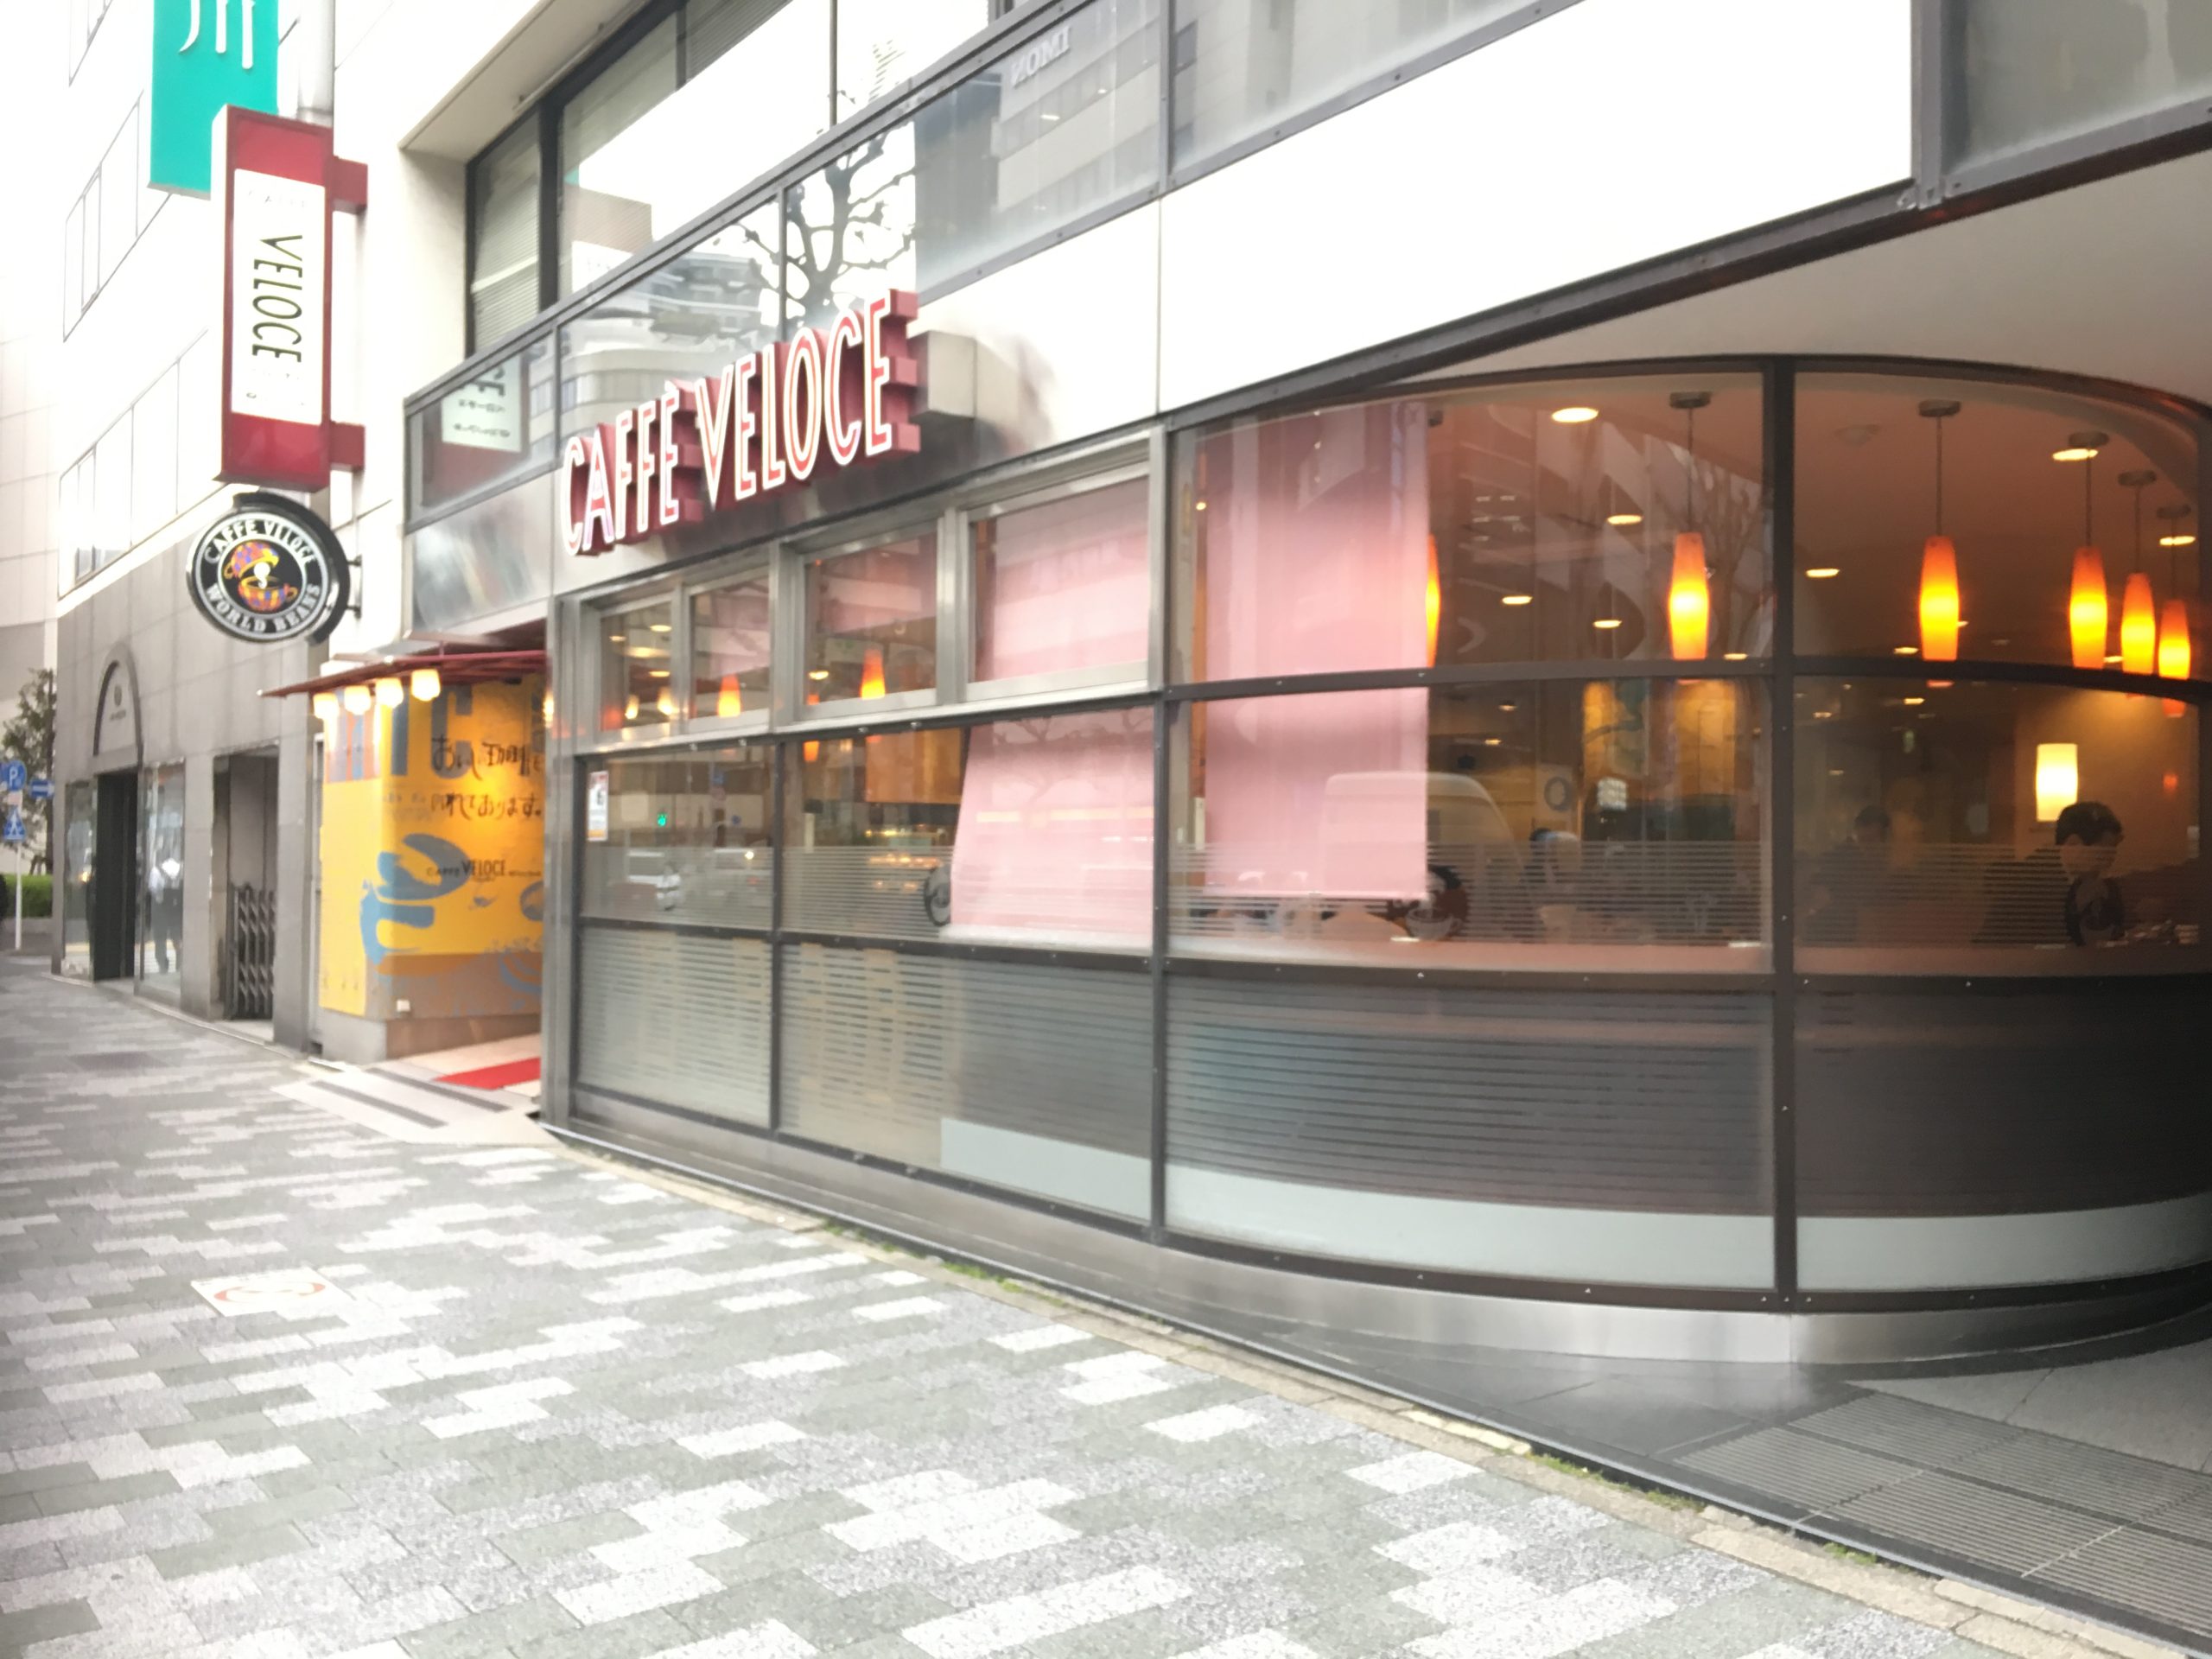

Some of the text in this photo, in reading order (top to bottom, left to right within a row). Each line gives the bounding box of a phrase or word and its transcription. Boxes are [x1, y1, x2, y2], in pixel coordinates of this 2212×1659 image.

[252, 235, 303, 363] VELOCE
[694, 289, 893, 510] VELOCE
[263, 519, 316, 565] VELOCE
[206, 582, 321, 633] WORLD BEANS
